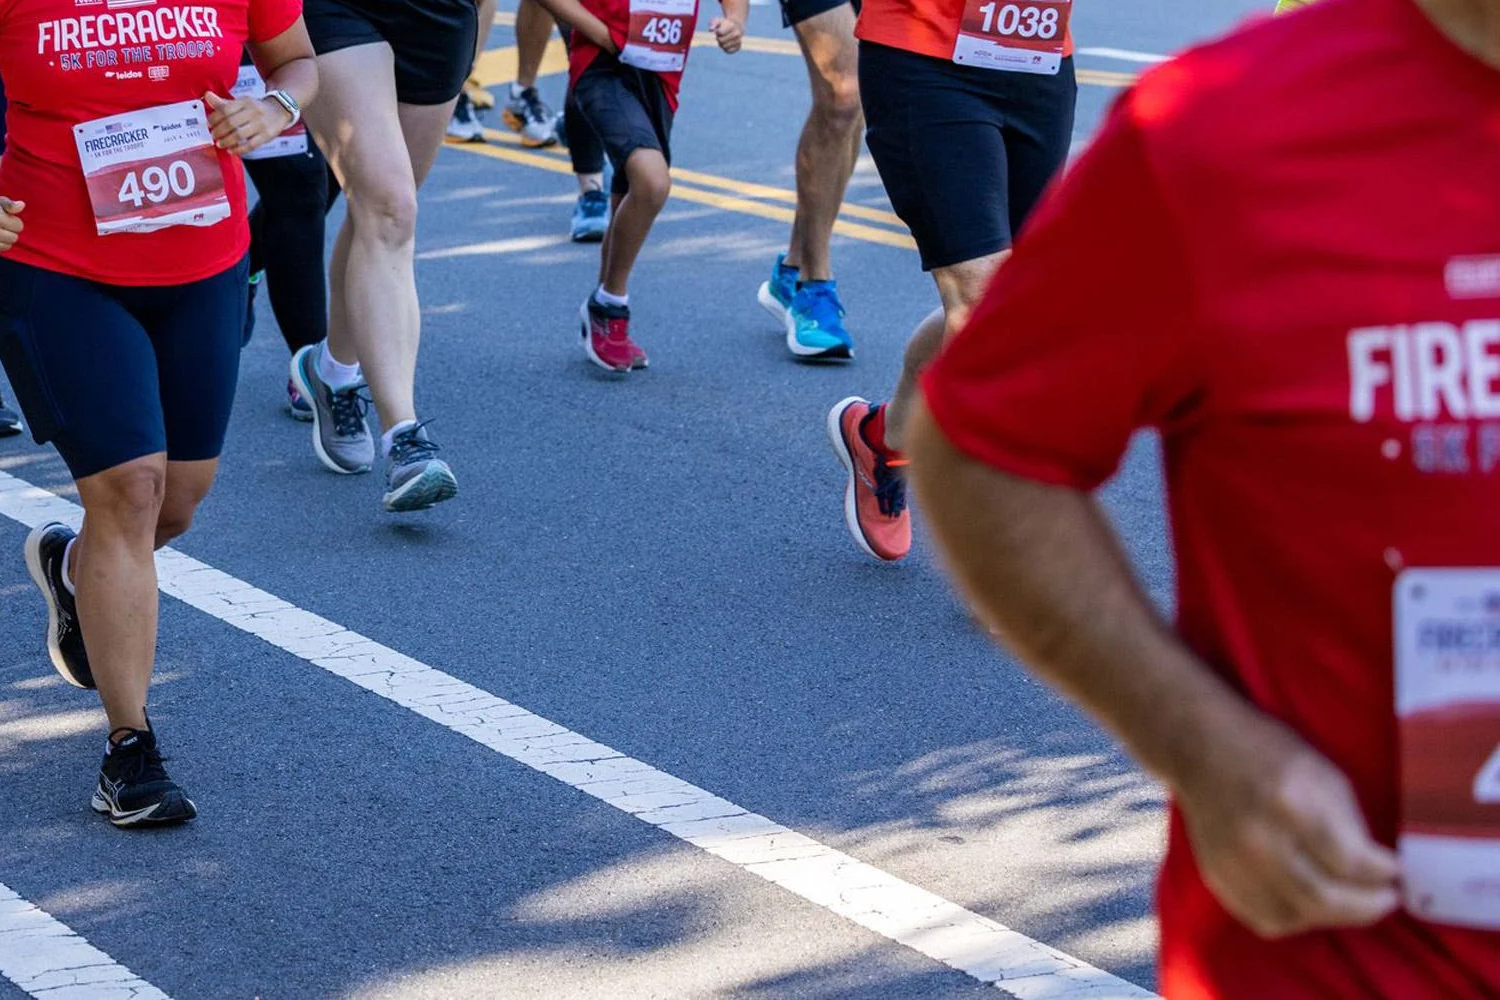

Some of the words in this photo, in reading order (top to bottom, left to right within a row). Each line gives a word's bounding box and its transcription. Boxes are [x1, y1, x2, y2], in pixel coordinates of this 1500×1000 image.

[38, 6, 223, 54] FIRECRACKER
[642, 18, 682, 44] 436
[979, 2, 1059, 39] 1038
[60, 54, 82, 71] 5K
[86, 51, 118, 69] FOR
[122, 47, 152, 64] THE
[157, 41, 214, 60] TROOPS
[116, 70, 142, 80] leidos
[85, 128, 149, 152] FIRECRACKER
[161, 123, 181, 132] leidos
[118, 160, 195, 207] 490
